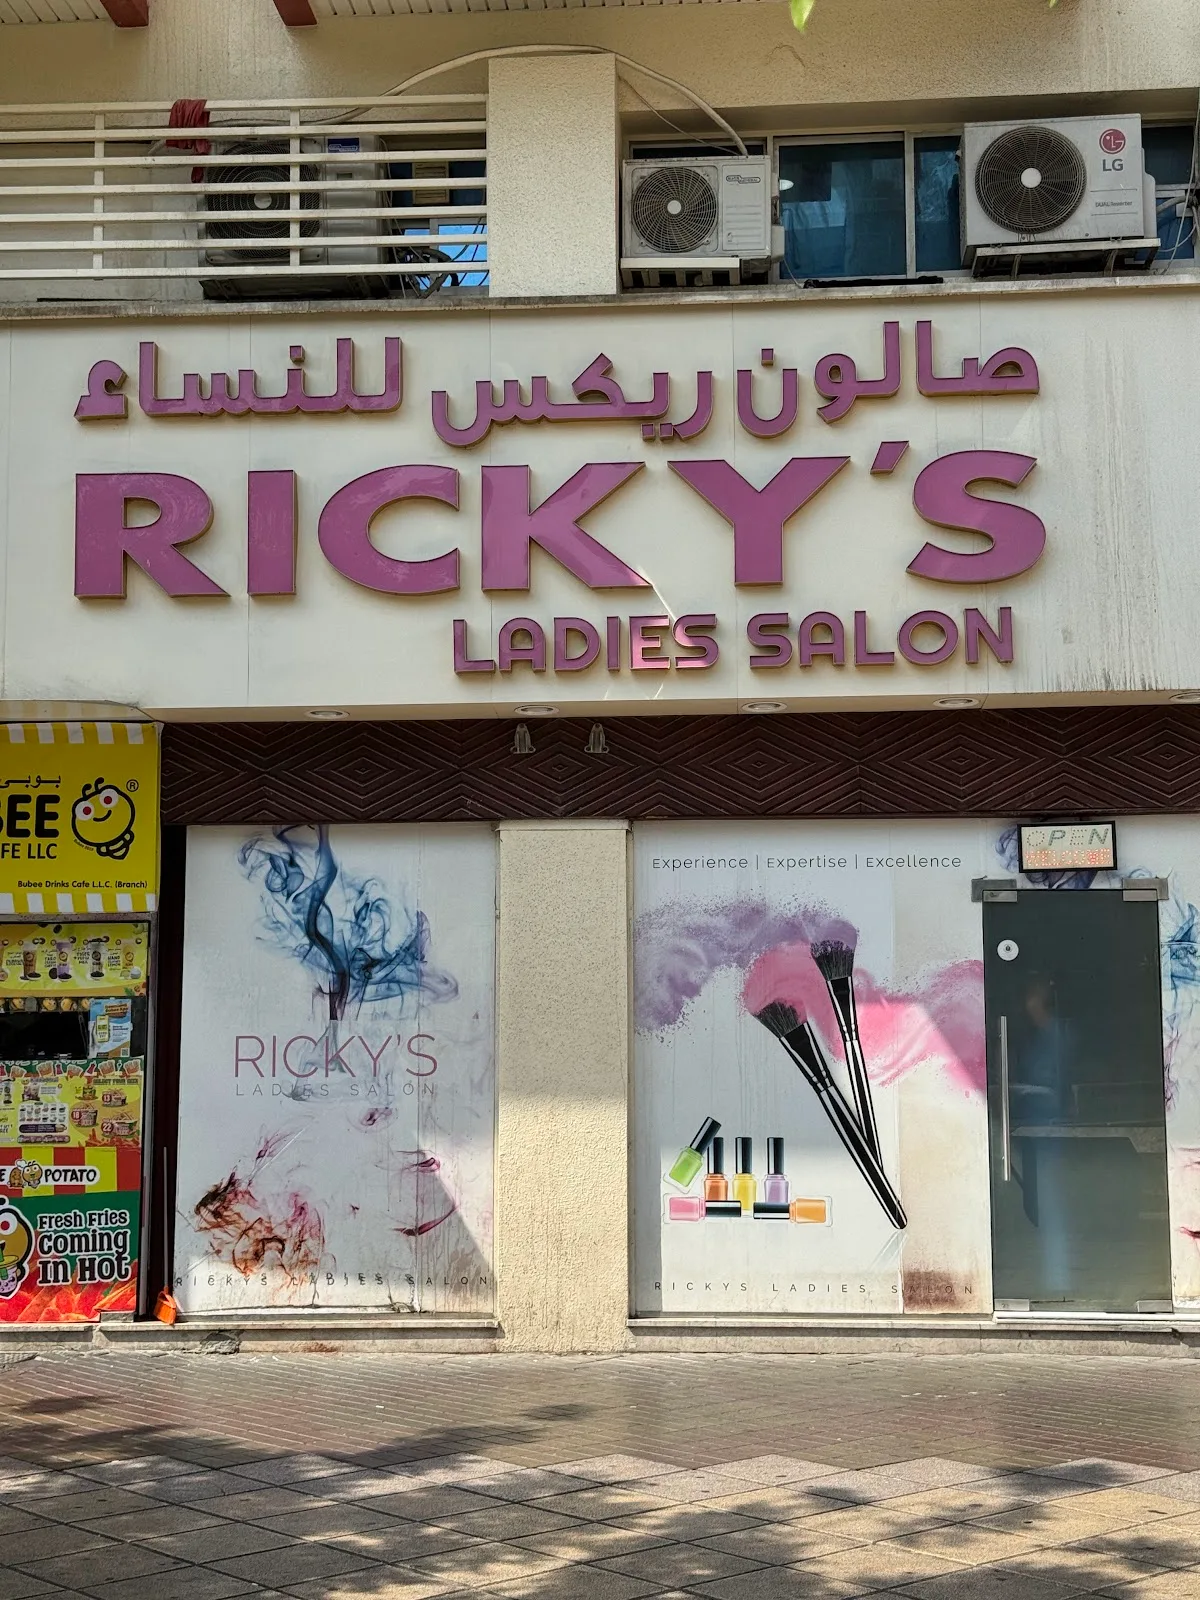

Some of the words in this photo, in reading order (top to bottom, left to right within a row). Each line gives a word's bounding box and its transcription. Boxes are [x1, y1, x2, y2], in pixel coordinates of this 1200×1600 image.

[1102, 158, 1124, 172] LG
[73, 336, 403, 422] للنساء
[736, 319, 1040, 439] صالون
[431, 352, 713, 448] ريكس
[74, 440, 1046, 599] RICKY'S
[453, 613, 719, 674] LADIES
[747, 607, 1013, 670] SALON
[0, 794, 61, 838] EE
[1026, 827, 1109, 847] OPEN
[27, 843, 57, 859] LLC
[1026, 848, 1111, 867] WELCOME
[652, 856, 749, 872] Experience
[767, 855, 847, 871] Expertise
[866, 854, 962, 868] Excellence
[18, 880, 42, 888] Bubee
[45, 880, 69, 888] Drinks
[72, 880, 90, 888] Cafe
[92, 880, 112, 888] L.L.C.
[115, 880, 148, 889] (Branch)
[234, 1034, 438, 1078] RICKY'S
[236, 1083, 330, 1097] LADIES
[350, 1082, 436, 1097] SALON
[44, 1168, 97, 1182] POTATO
[39, 1212, 83, 1229] Fresh
[88, 1210, 127, 1227] Fries
[405, 1273, 488, 1287] SALON
[654, 1281, 748, 1292] RICKYS
[772, 1282, 866, 1294] LADIES
[891, 1284, 973, 1295] SALON
